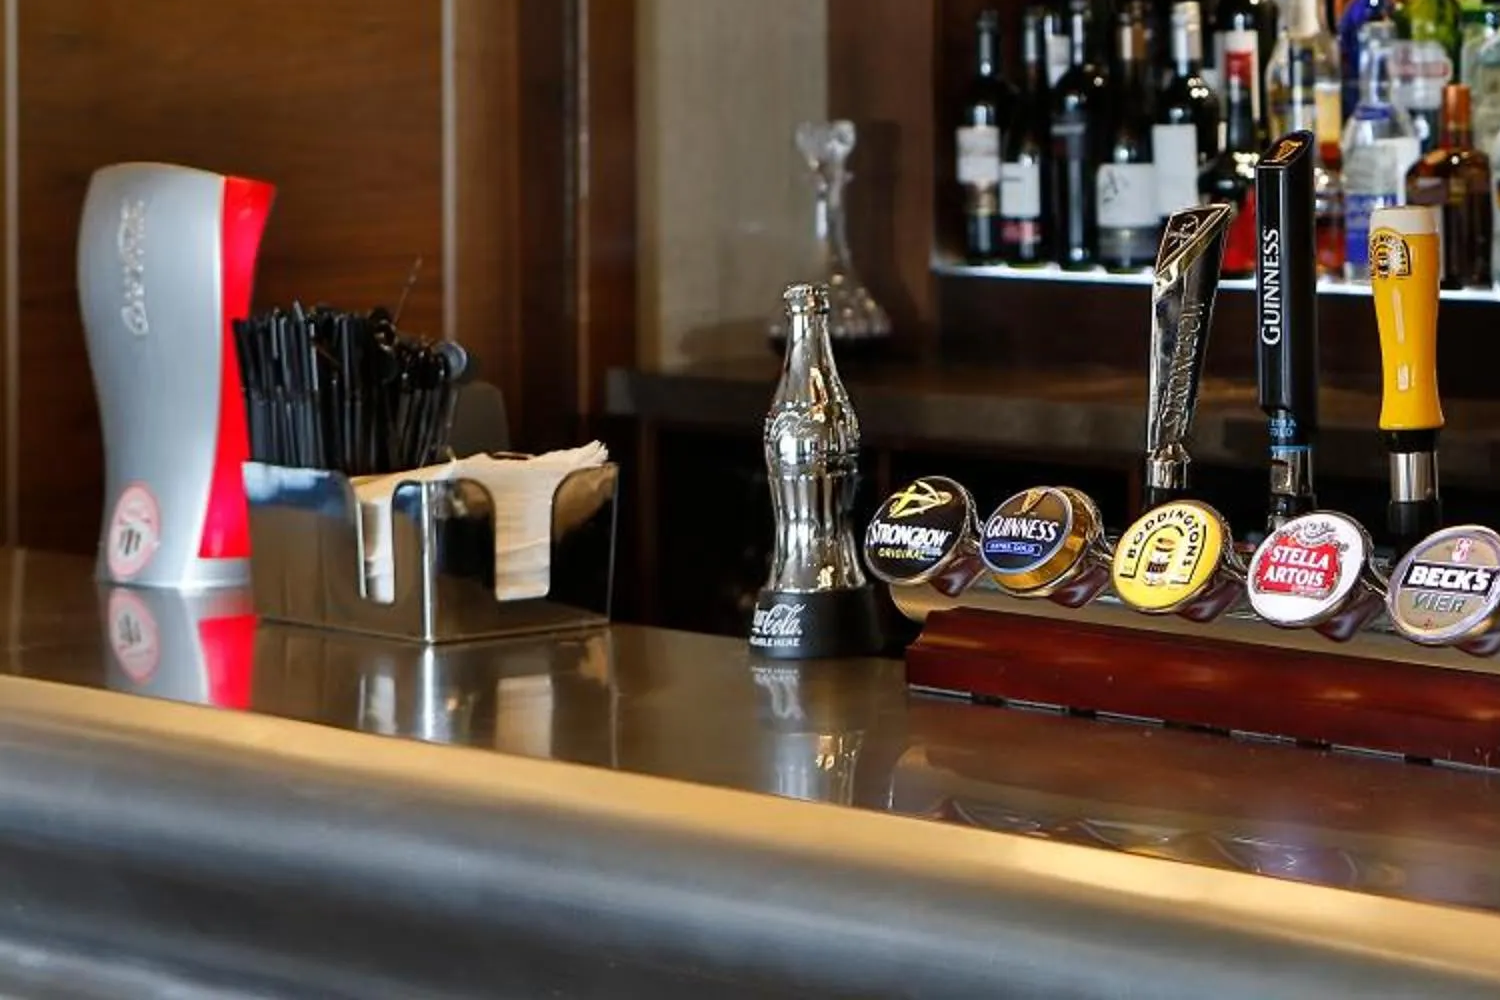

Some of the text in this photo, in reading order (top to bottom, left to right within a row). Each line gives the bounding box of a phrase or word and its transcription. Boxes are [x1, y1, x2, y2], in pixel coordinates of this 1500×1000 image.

[1261, 228, 1281, 346] GUINNESS
[868, 520, 953, 549] STRONGBOW
[986, 515, 1060, 543] GUINNESS
[1126, 508, 1200, 568] BODDINGTONS
[1269, 544, 1330, 571] STELLA
[1262, 563, 1326, 588] ARTOIS
[1411, 592, 1466, 613] VIER
